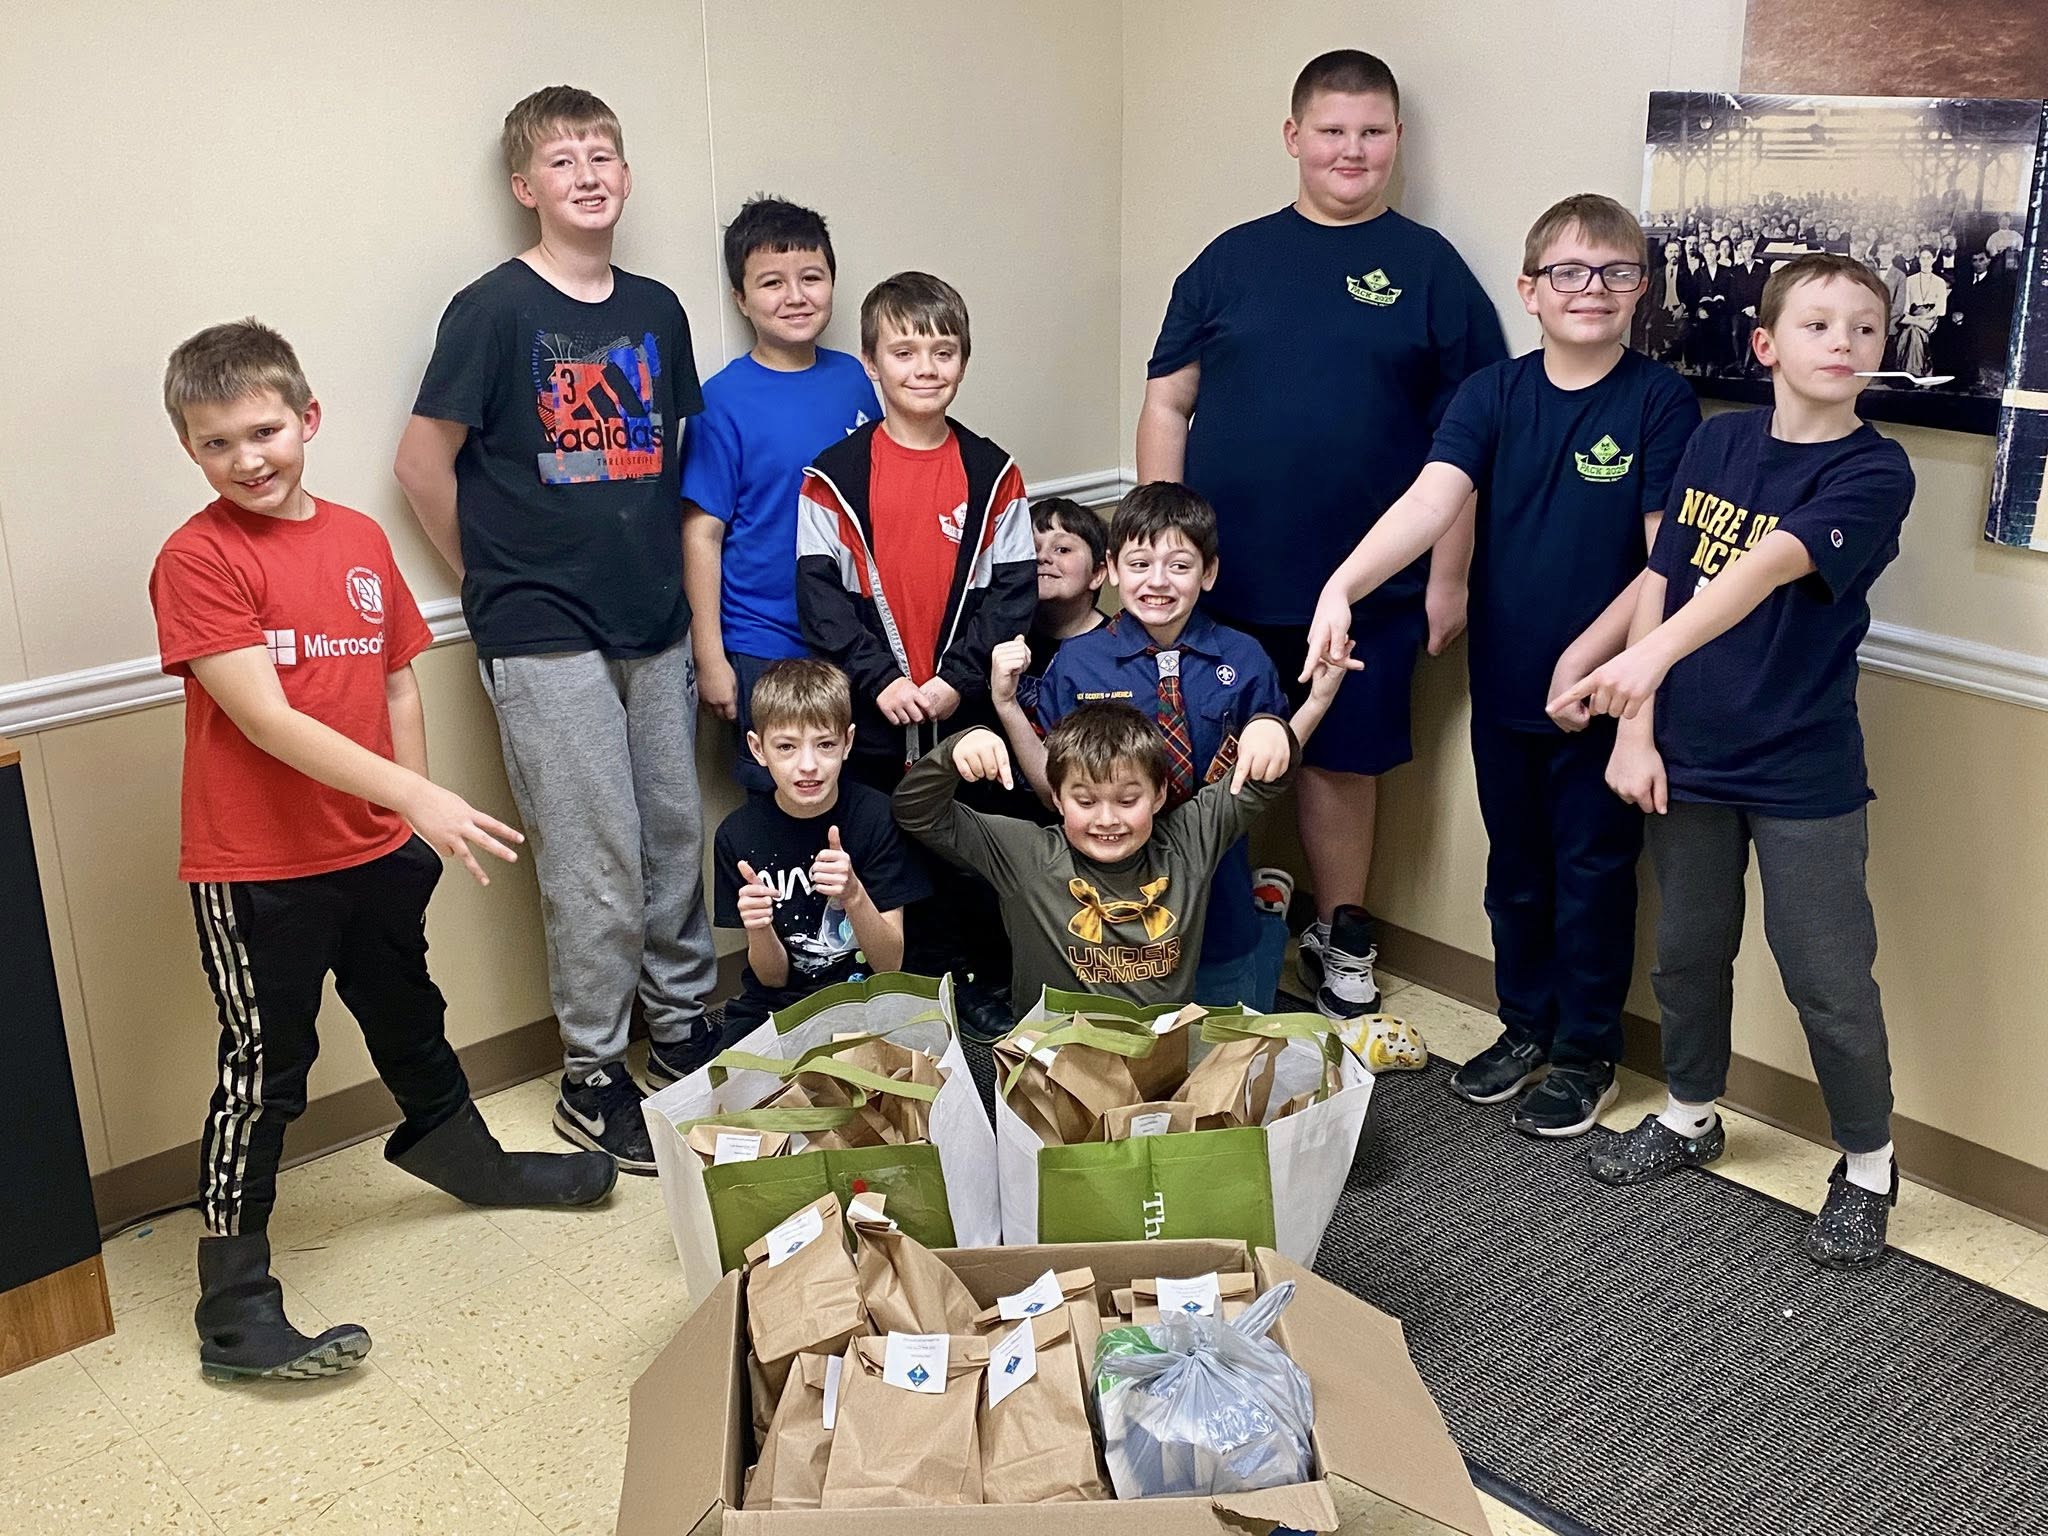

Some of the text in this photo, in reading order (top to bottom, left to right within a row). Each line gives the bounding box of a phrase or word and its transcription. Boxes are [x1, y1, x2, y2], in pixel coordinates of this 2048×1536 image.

[1350, 286, 1372, 298] PACK
[560, 369, 577, 405] 3
[558, 420, 663, 453] adidas
[1580, 463, 1603, 475] PACK
[303, 631, 384, 658] Microso
[1111, 691, 1133, 699] AMERICA
[1068, 937, 1181, 968] UNDER
